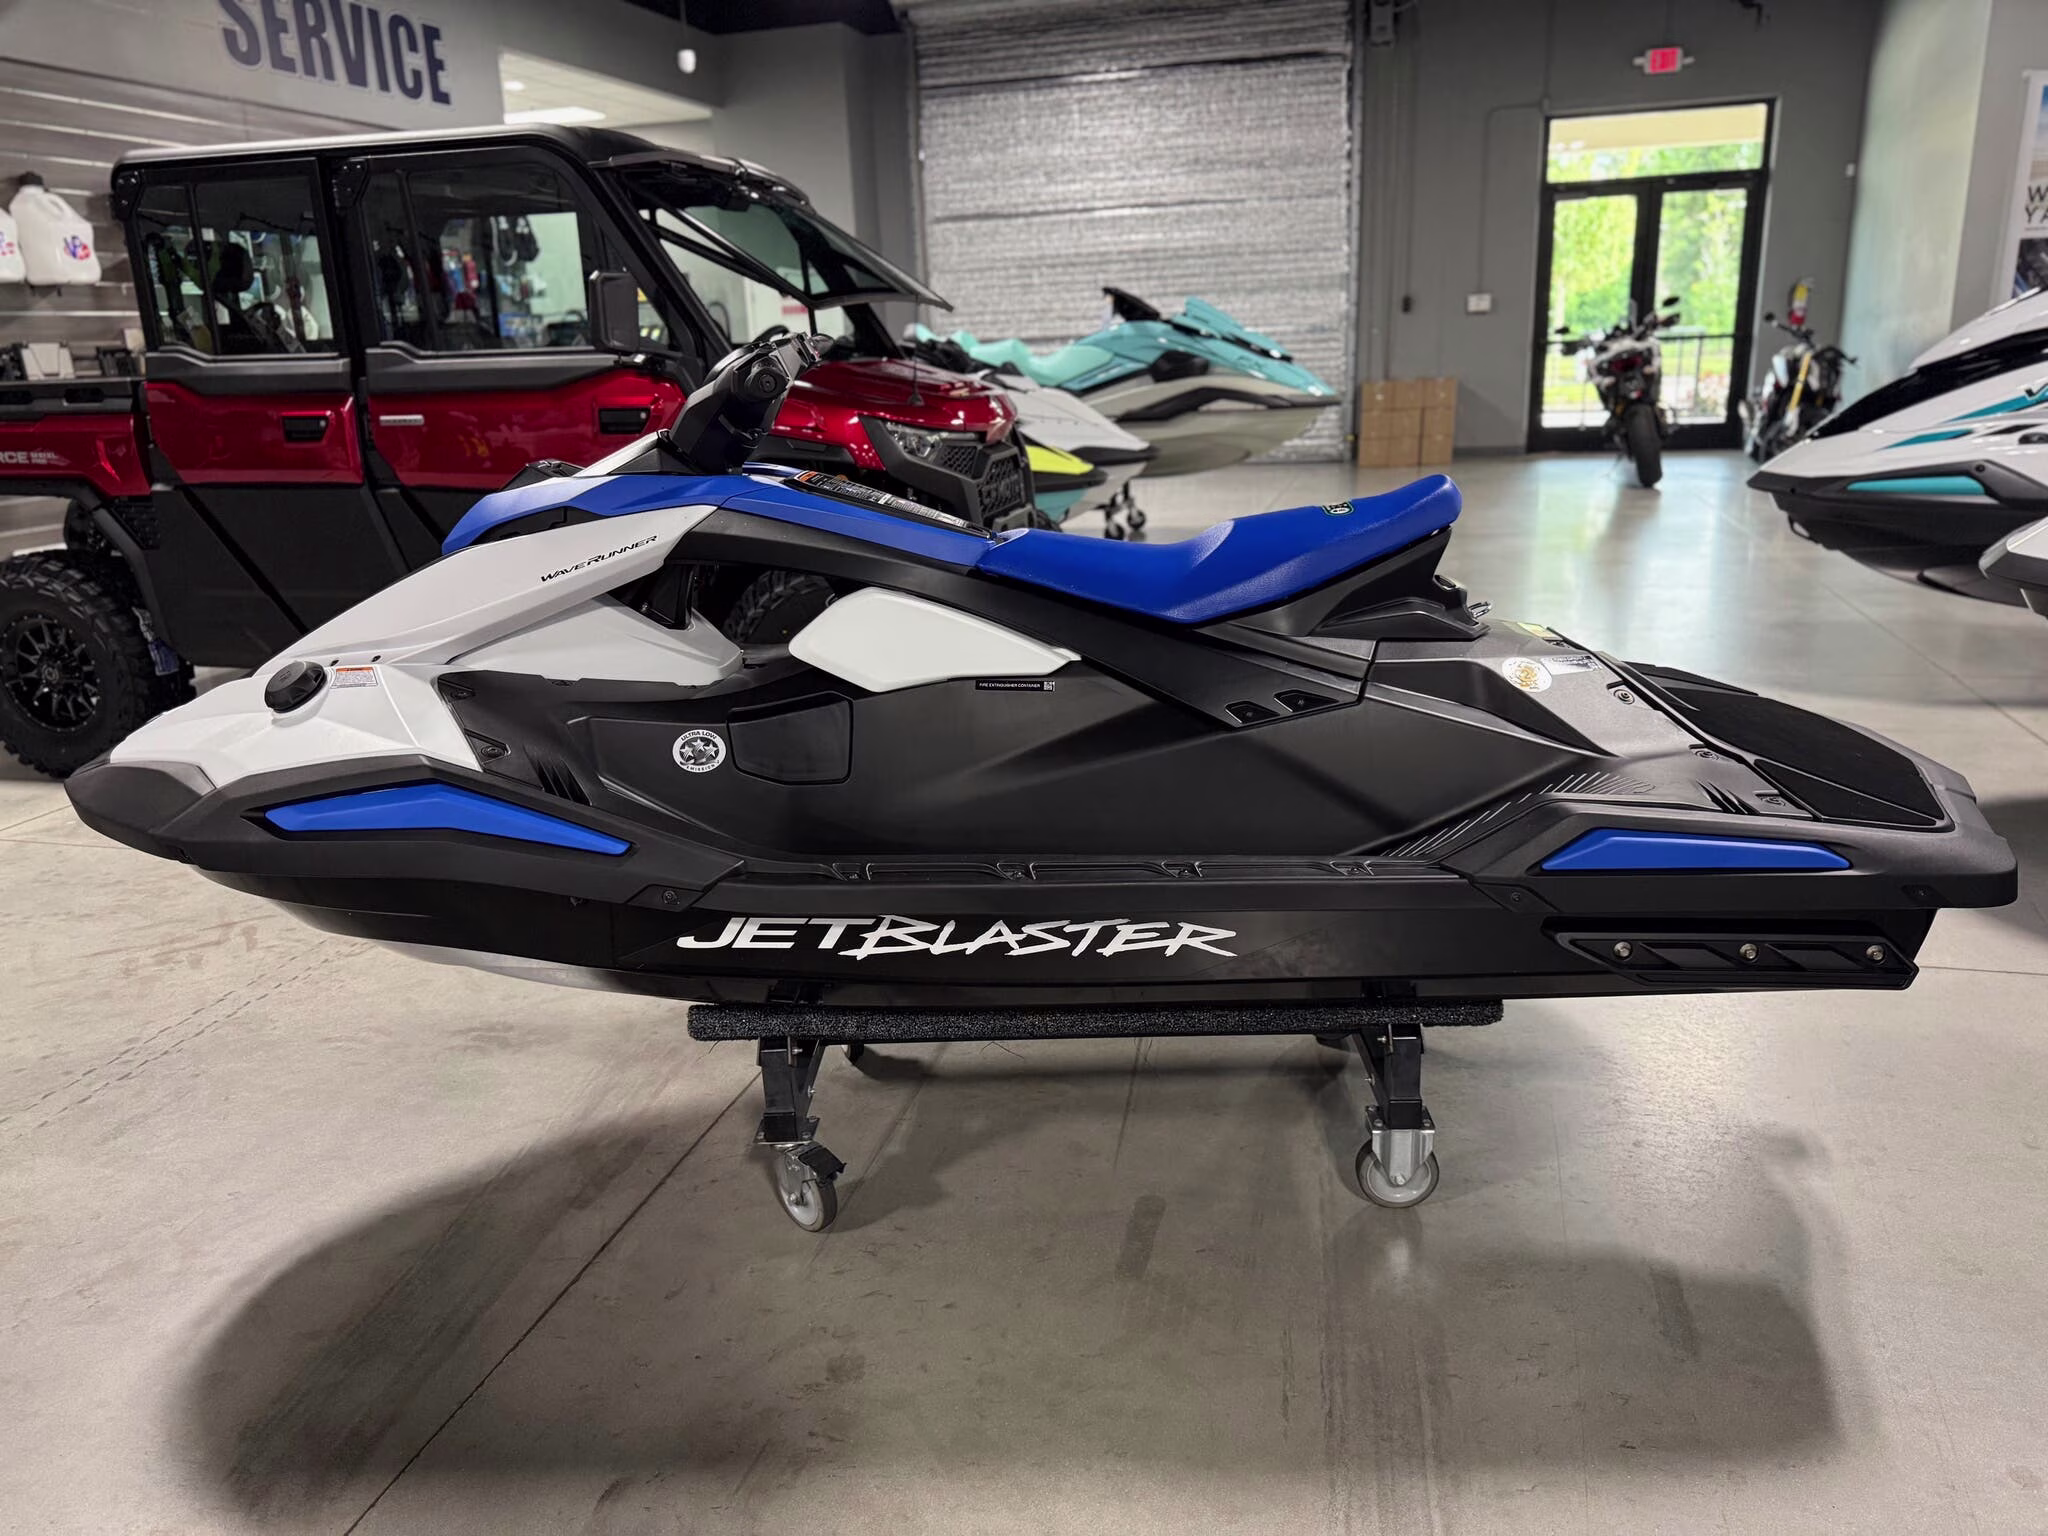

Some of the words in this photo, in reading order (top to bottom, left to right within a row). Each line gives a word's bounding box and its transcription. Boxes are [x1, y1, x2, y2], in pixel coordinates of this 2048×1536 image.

[219, 0, 452, 106] SERVICE
[541, 535, 657, 582] WAVERUNNER
[680, 730, 701, 741] ULTRA
[702, 731, 718, 740] LOW
